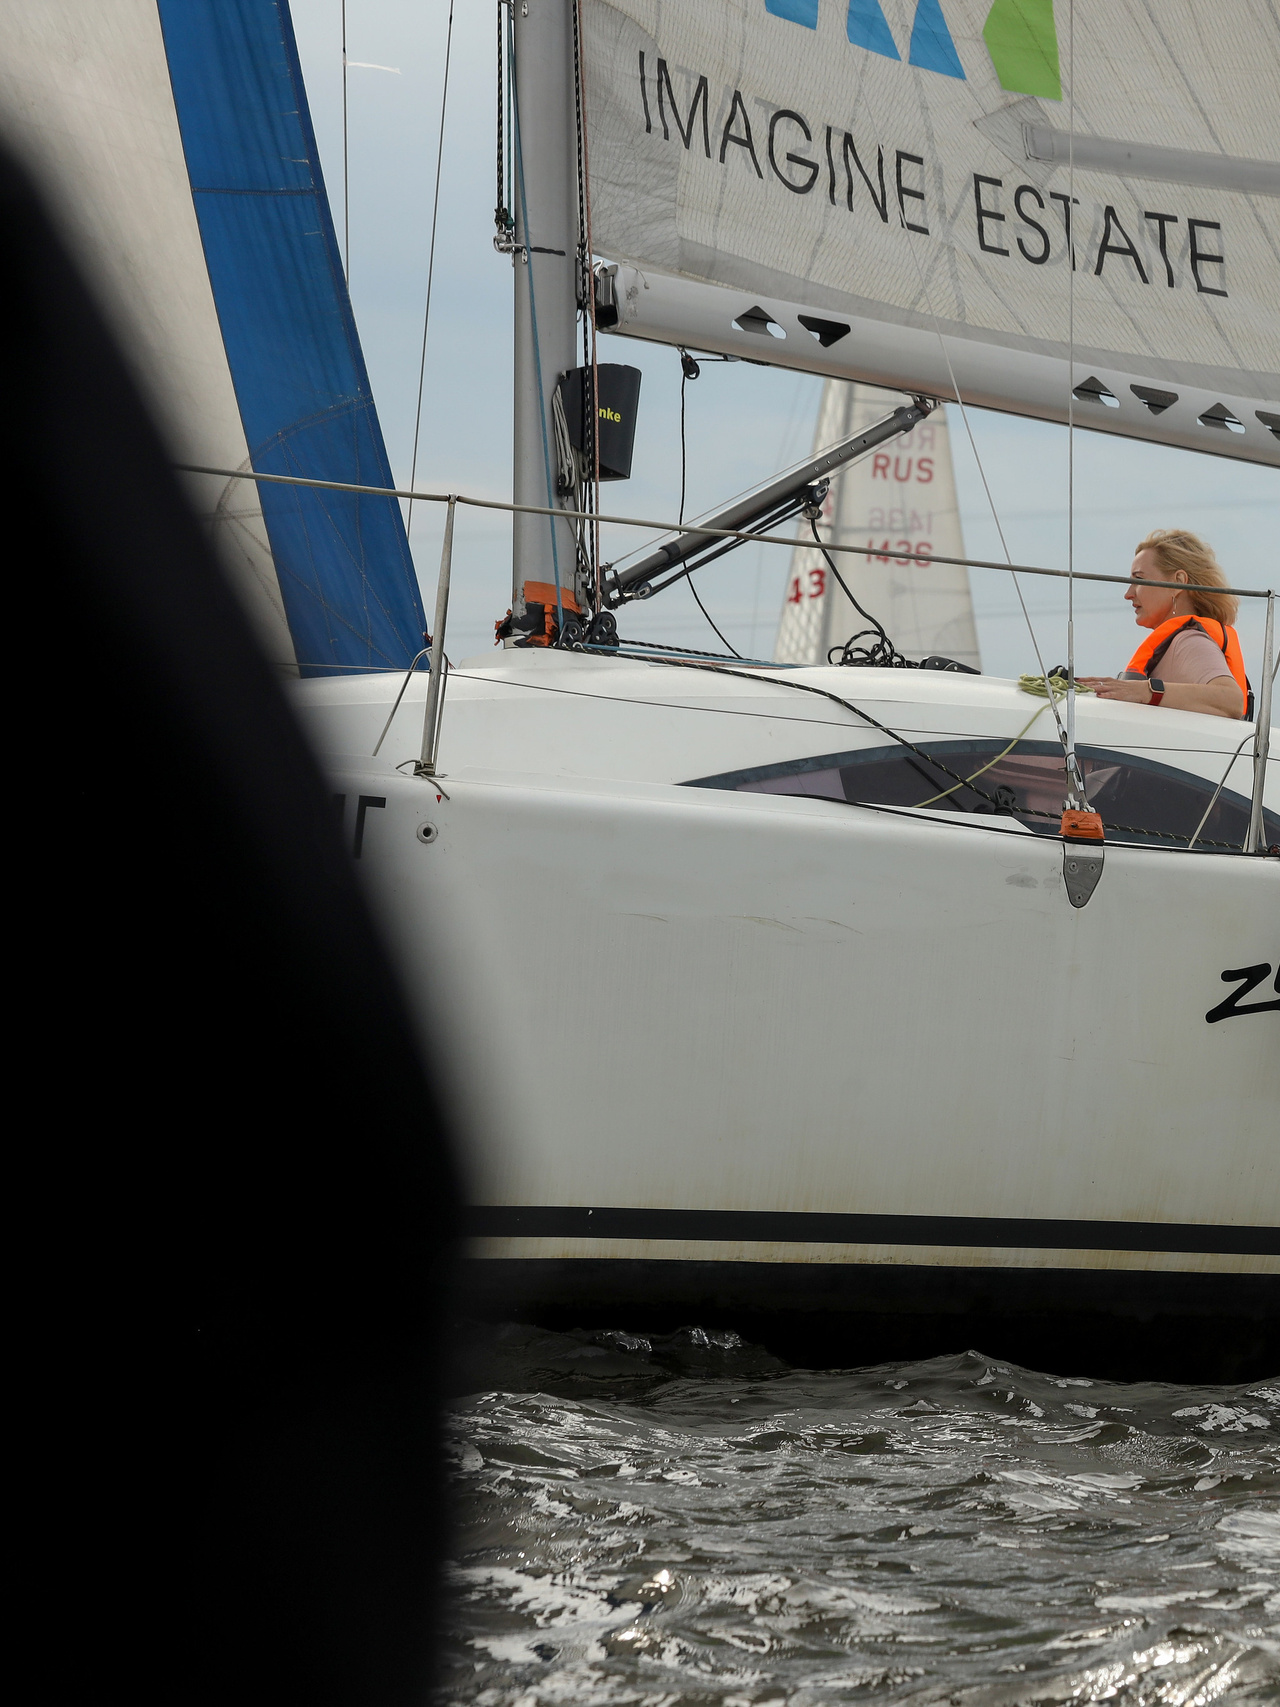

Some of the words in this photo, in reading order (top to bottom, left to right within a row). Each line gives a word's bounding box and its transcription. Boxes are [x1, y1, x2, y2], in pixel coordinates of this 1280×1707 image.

[638, 50, 930, 236] IMAGINE
[972, 172, 1229, 299] ESTATE
[871, 453, 935, 484] RUS
